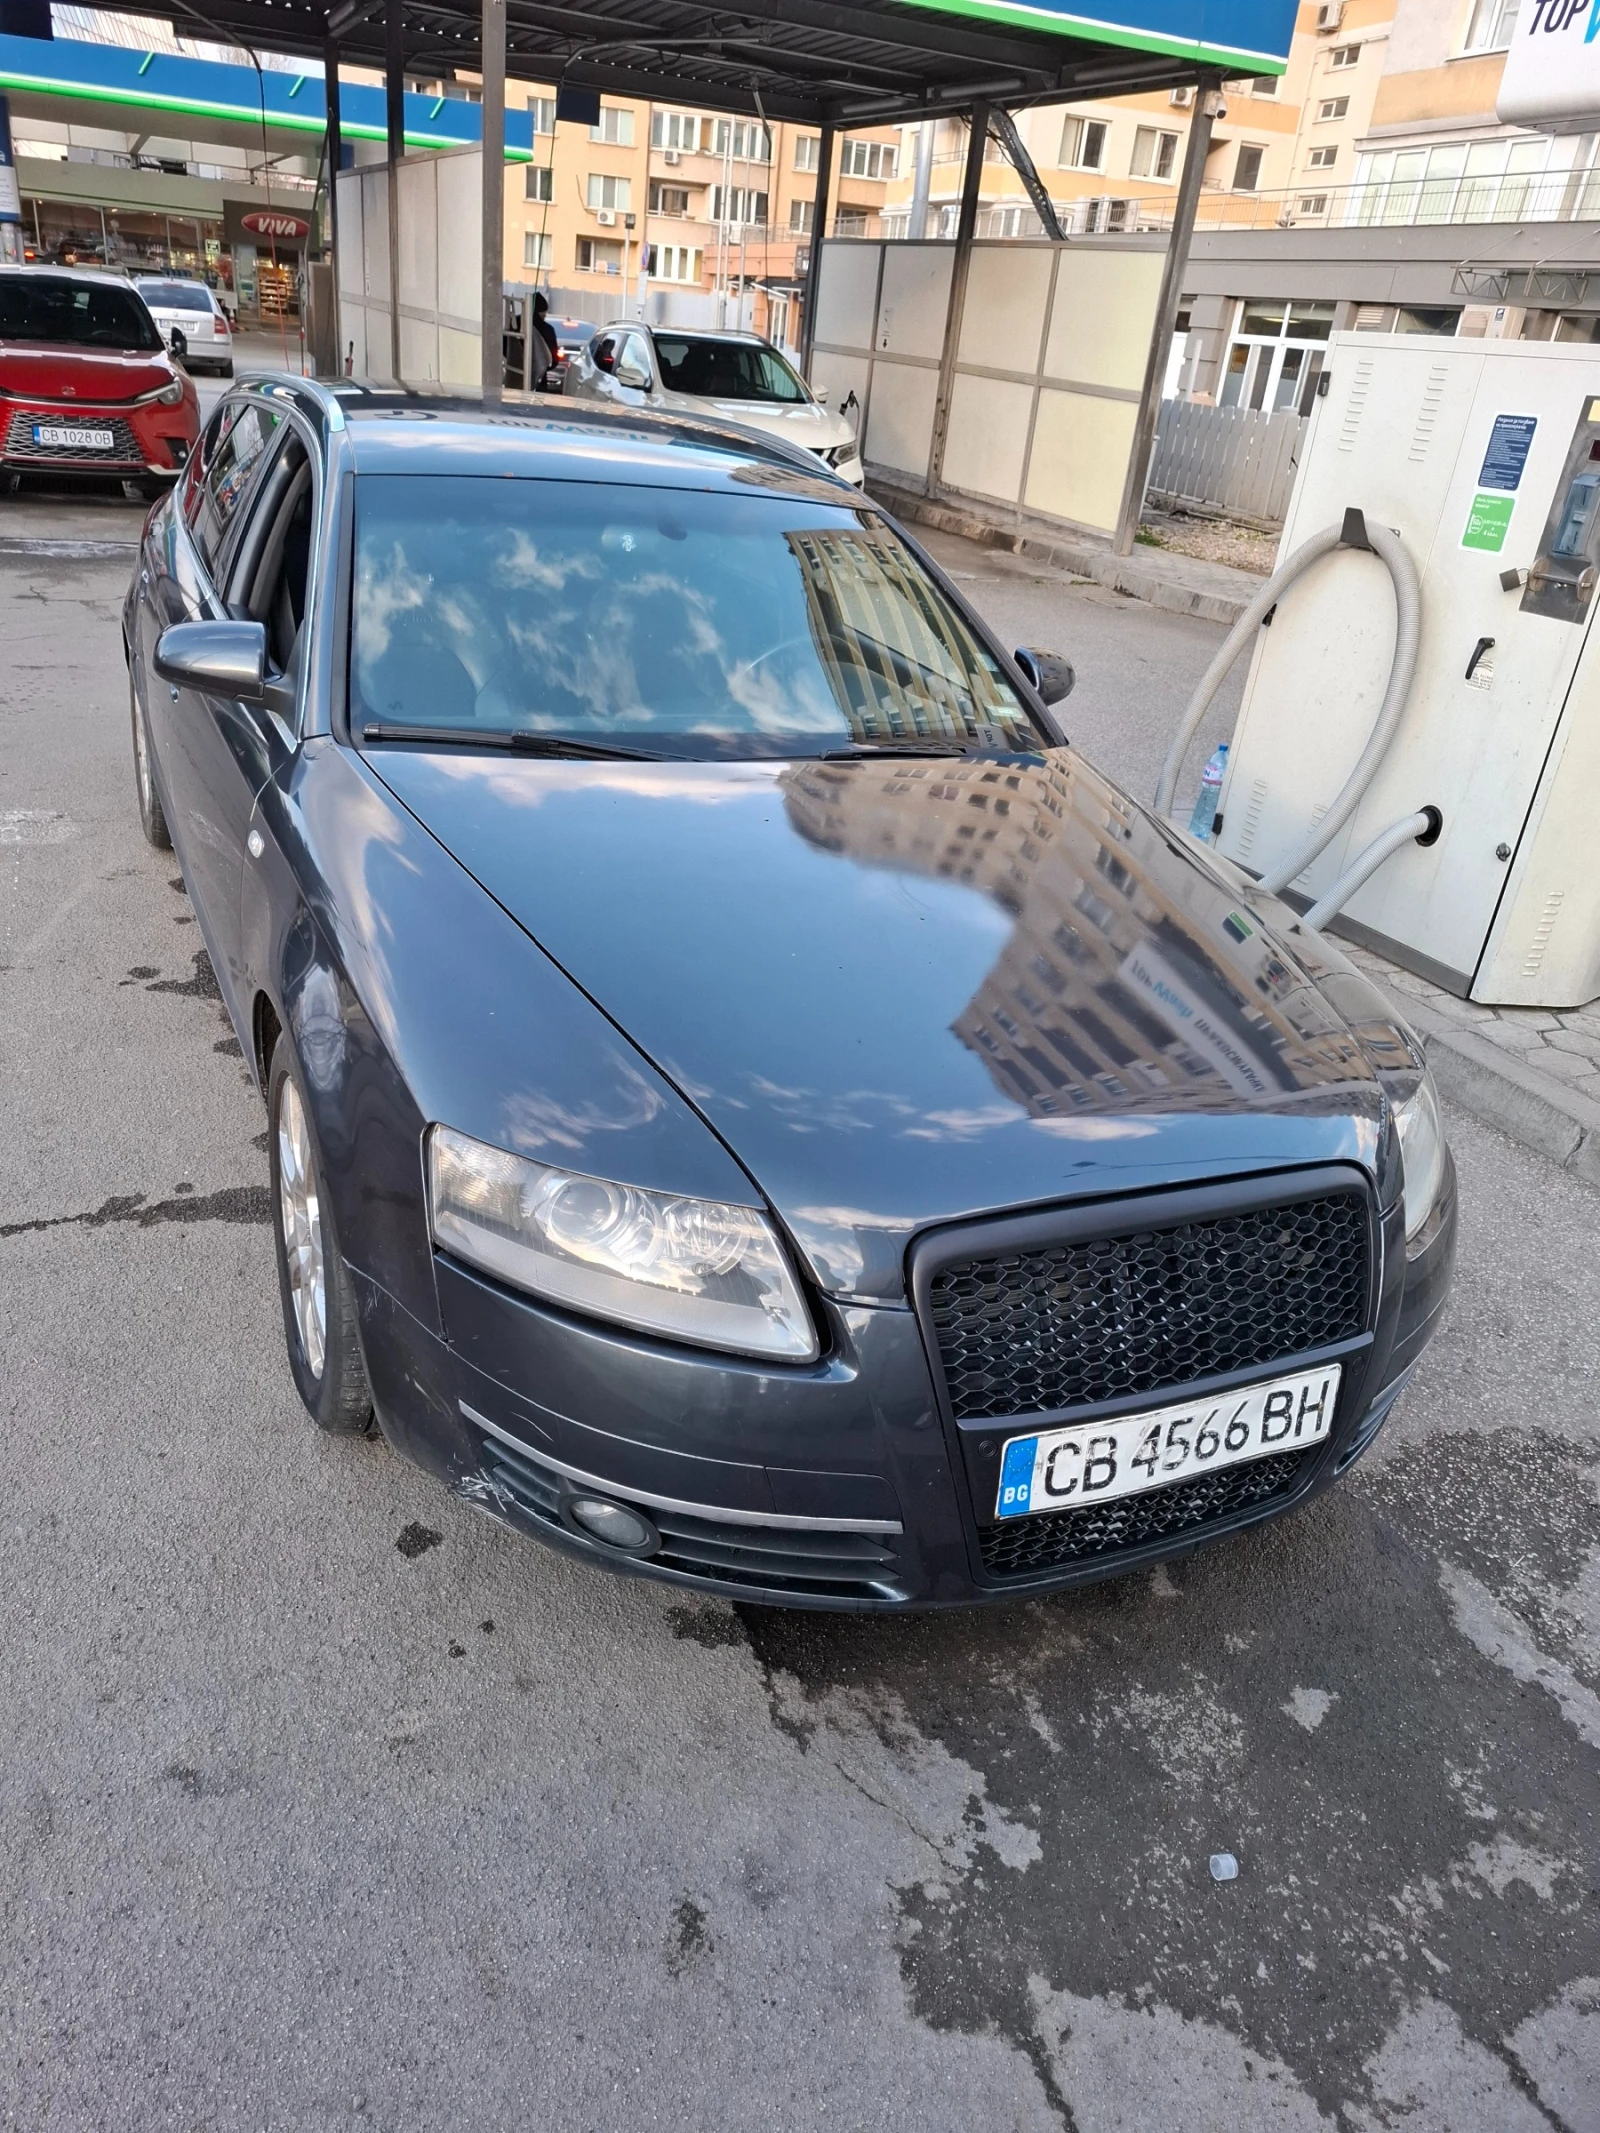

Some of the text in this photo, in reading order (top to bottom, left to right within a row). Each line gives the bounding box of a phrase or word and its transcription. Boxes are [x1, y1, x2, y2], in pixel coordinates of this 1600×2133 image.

[258, 217, 297, 236] VIVA
[42, 429, 59, 442] CB
[63, 430, 92, 444] 1028
[1044, 1379, 1330, 1497] CB 4566 BH
[1003, 1484, 1029, 1505] BG
